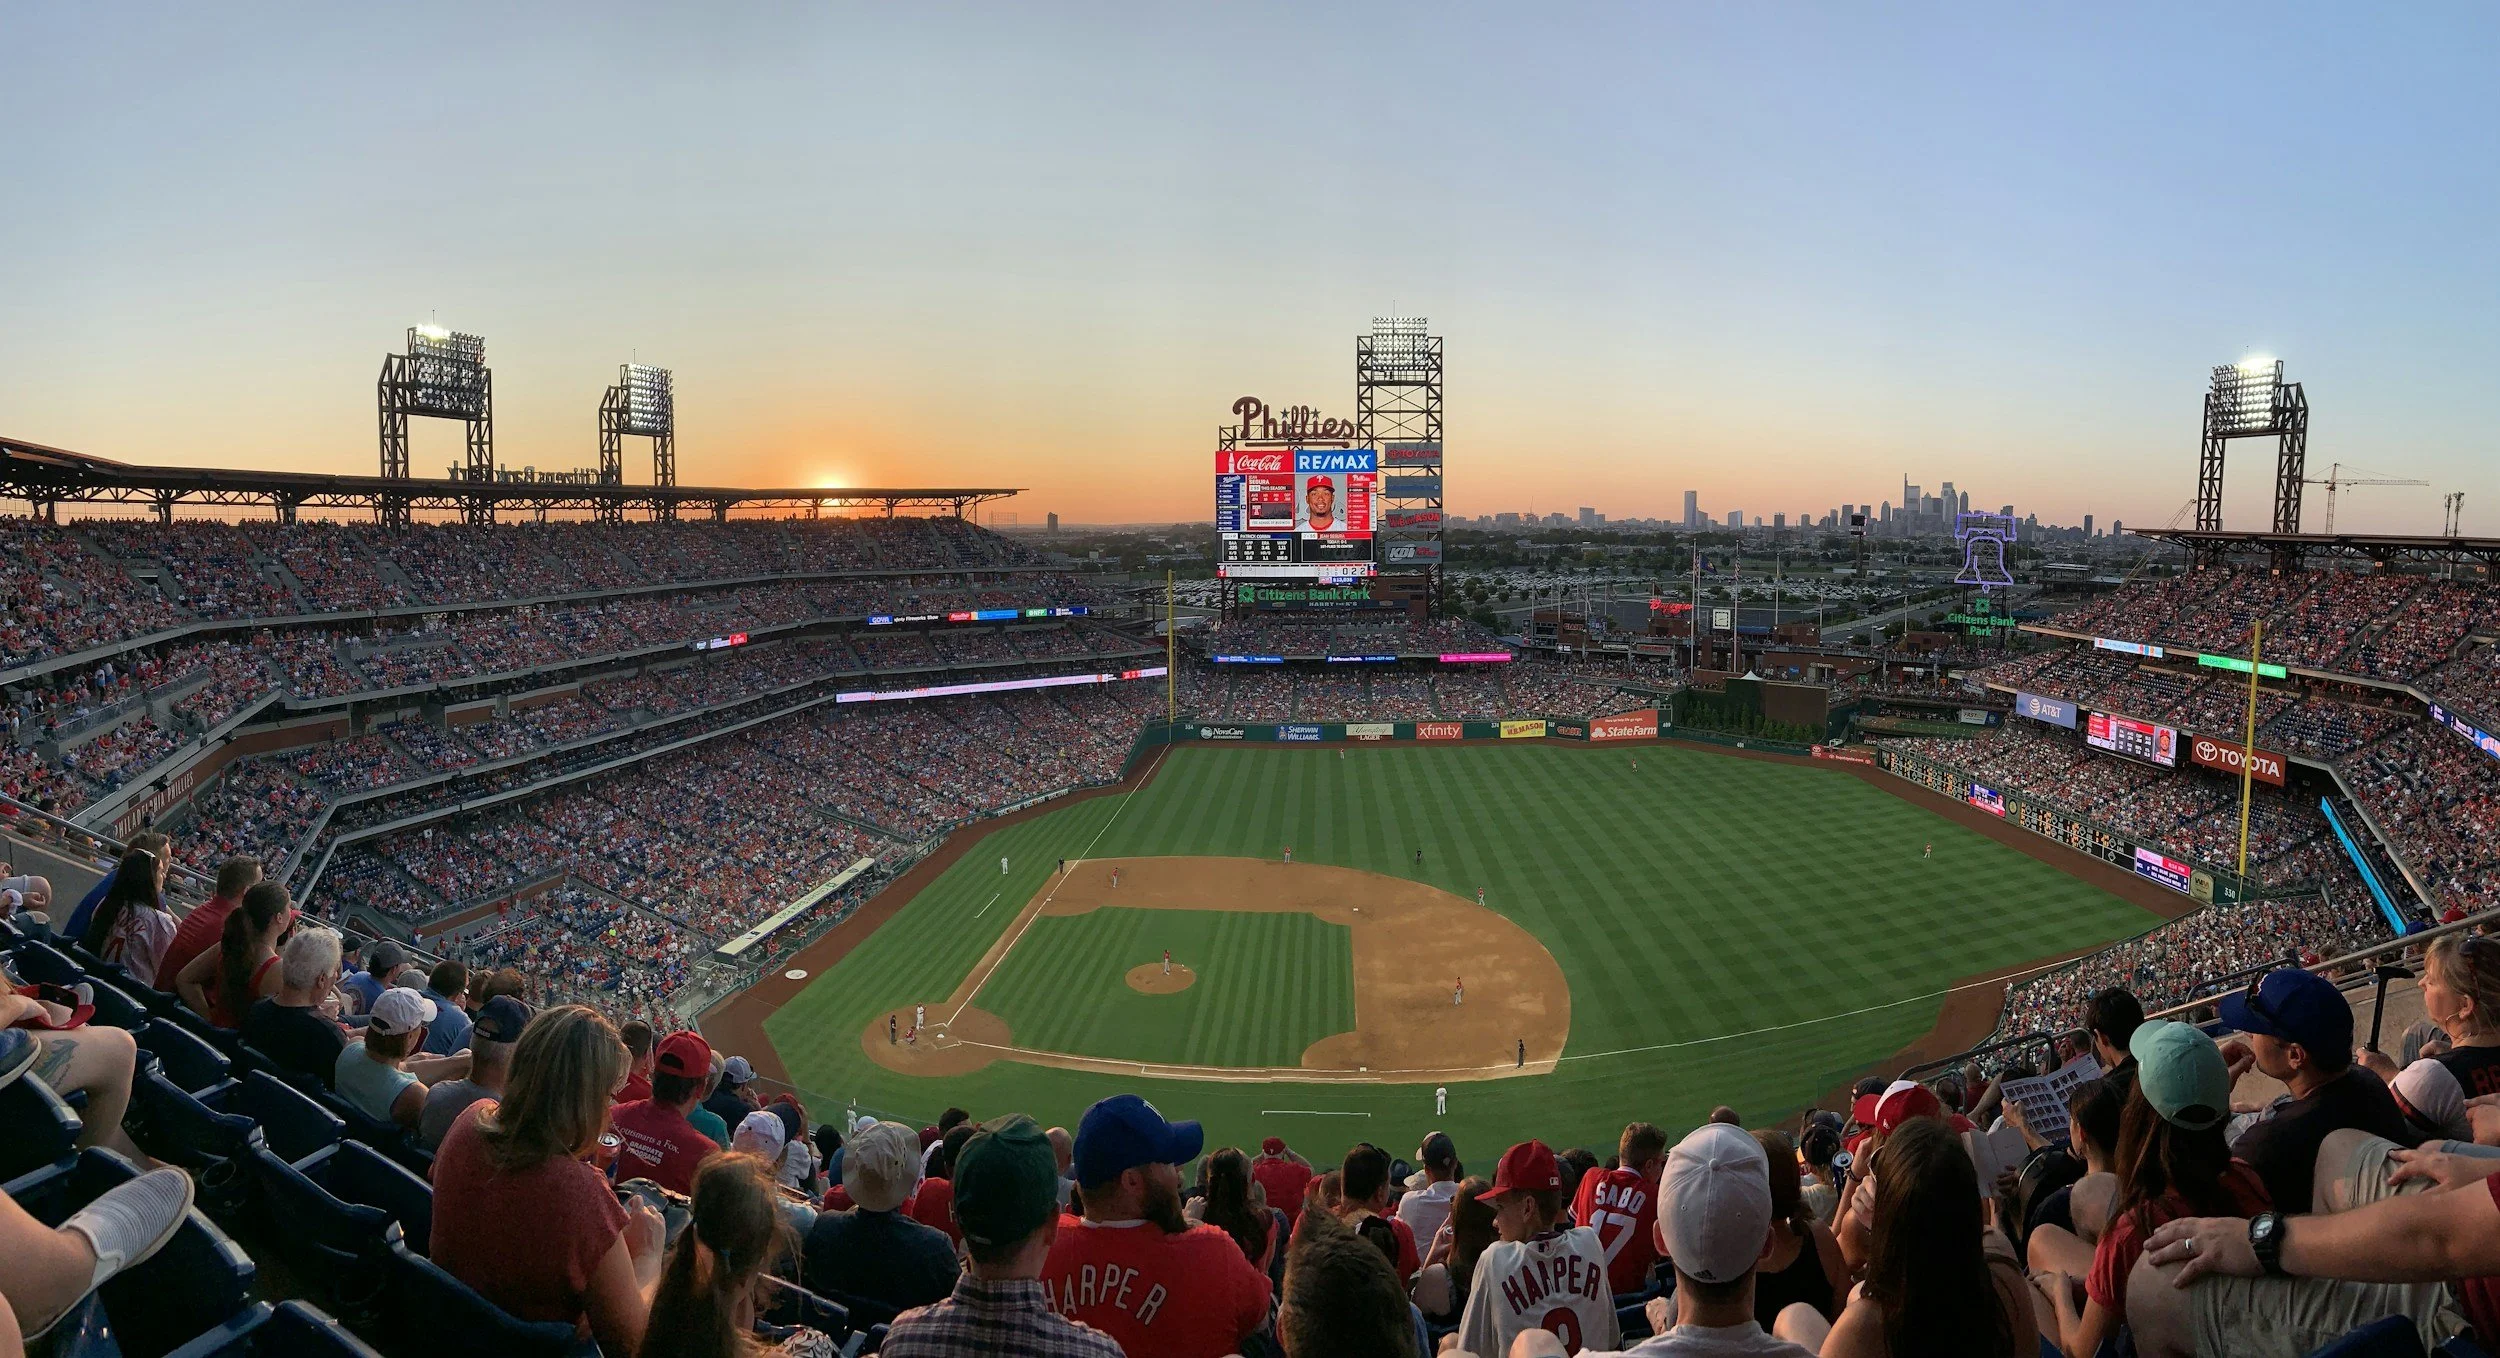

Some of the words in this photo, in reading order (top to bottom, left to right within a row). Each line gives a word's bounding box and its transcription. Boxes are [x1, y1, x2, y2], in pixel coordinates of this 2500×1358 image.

[1232, 396, 1354, 440] Phillies
[1236, 455, 1284, 471] Coca-Cola
[1300, 455, 1370, 469] RE/MAX
[1257, 589, 1306, 600] Citizens
[1309, 588, 1339, 600] Bank
[1343, 587, 1370, 600] Park
[1947, 613, 1989, 626] Citizens
[1990, 614, 2016, 627] Bank
[1970, 626, 1992, 636] Park
[2041, 704, 2061, 718] AT&T
[1419, 724, 1460, 738] xfinity
[2219, 748, 2280, 777] TOYOTA
[168, 771, 193, 802] PHILLIES
[620, 1128, 655, 1144] outsmarts
[664, 1139, 680, 1154] Fox.
[630, 1141, 664, 1158] GRADUATE
[626, 1146, 662, 1165] PROGRAMS
[1595, 1182, 1646, 1214] SABO
[1589, 1209, 1637, 1266] 17
